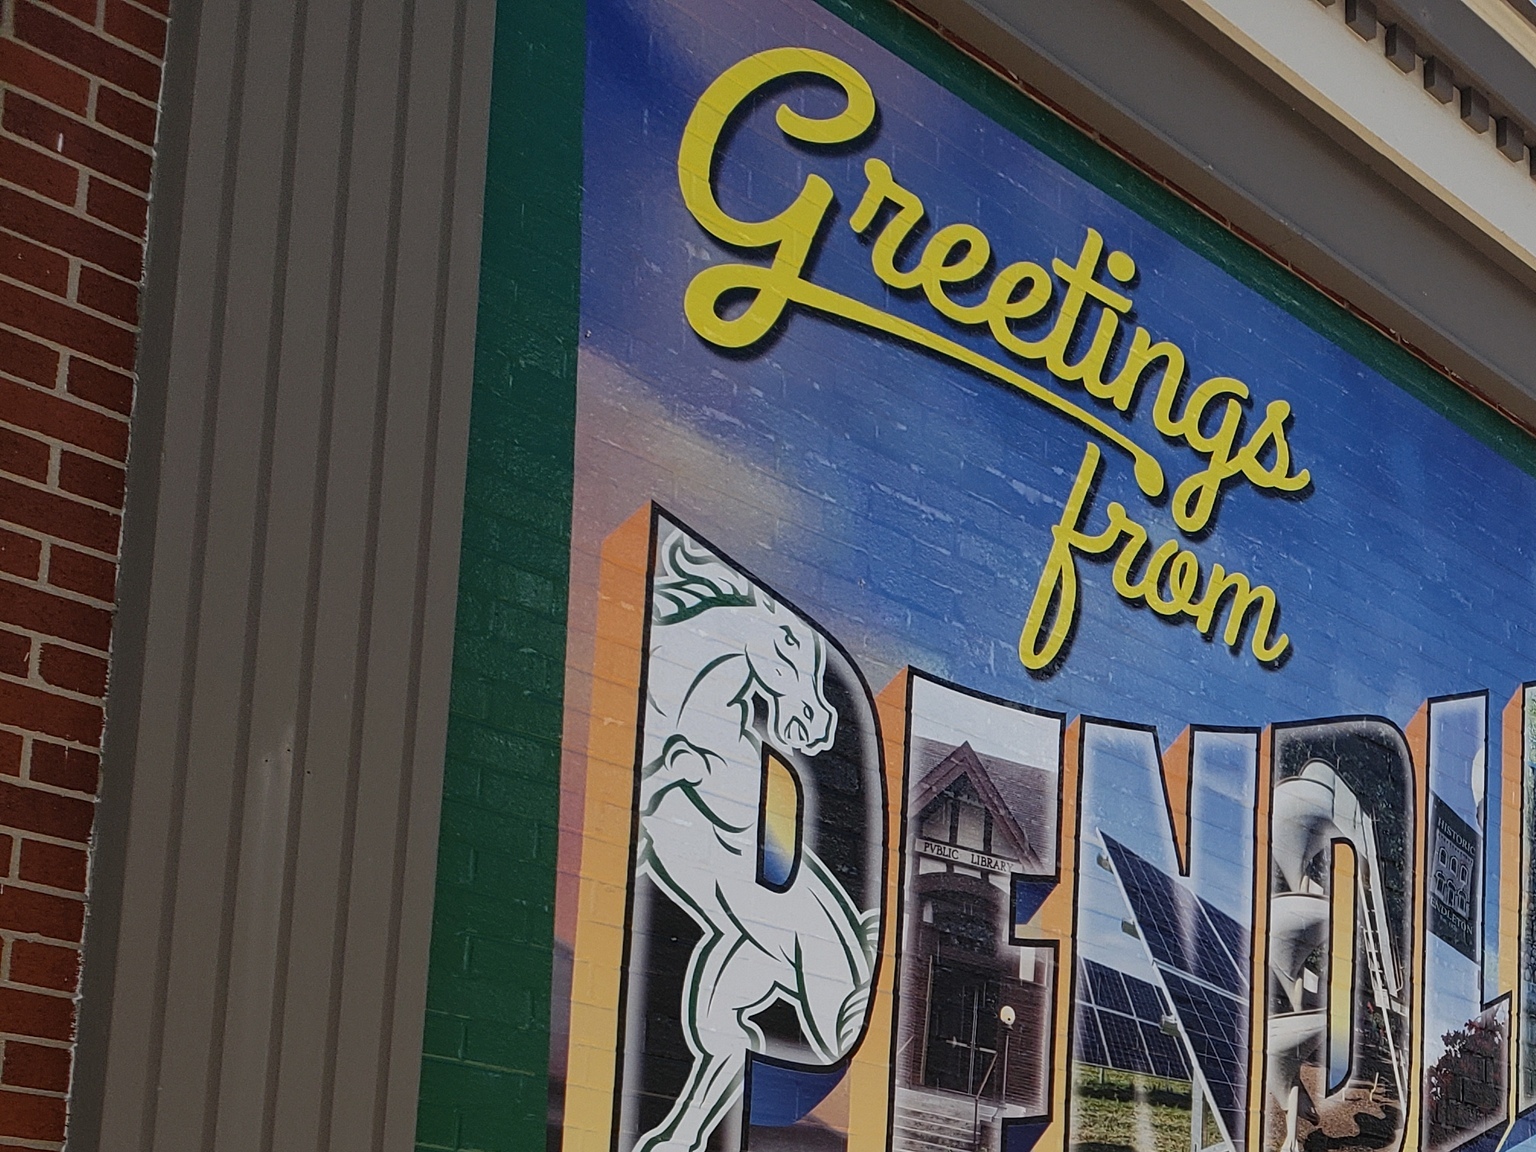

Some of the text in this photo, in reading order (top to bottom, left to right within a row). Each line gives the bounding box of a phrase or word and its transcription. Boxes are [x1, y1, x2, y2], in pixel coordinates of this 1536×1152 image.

[677, 46, 1311, 532] Greetings
[1018, 441, 1290, 670] from
[970, 854, 1014, 872] LIBRARY
[1437, 817, 1476, 856] HISTORIC
